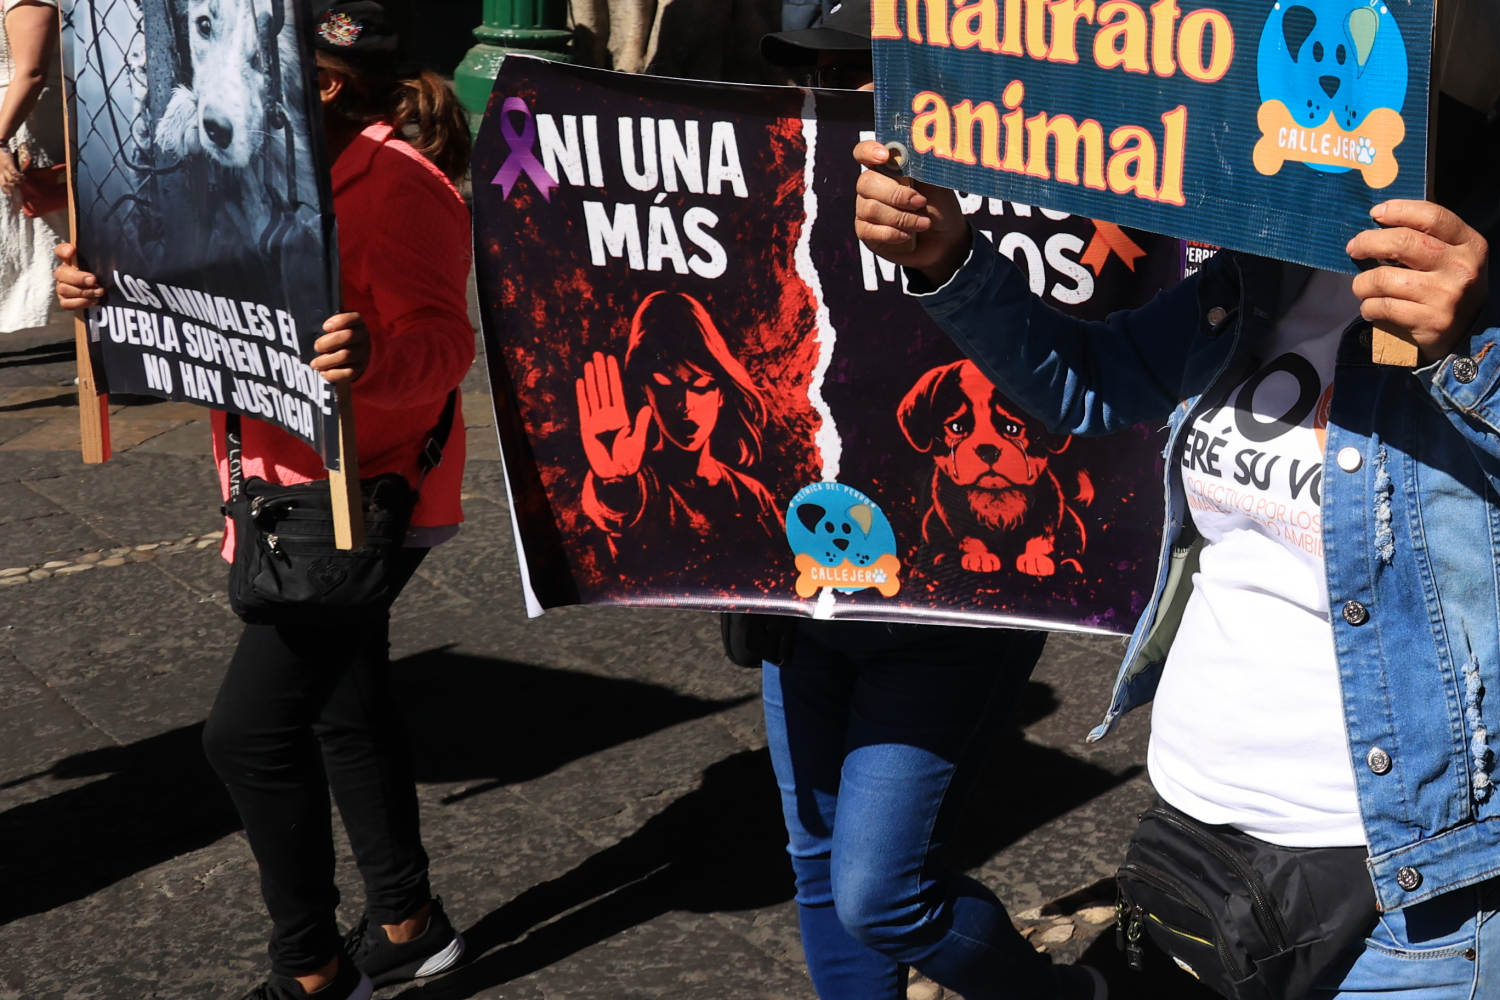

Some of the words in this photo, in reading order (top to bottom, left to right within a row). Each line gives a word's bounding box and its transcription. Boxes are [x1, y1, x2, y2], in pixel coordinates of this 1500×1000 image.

[536, 113, 604, 188] NI
[618, 116, 749, 198] UNA
[911, 79, 1188, 207] animal
[583, 192, 728, 279] MÁS
[90, 305, 181, 353] PUEBLA
[182, 322, 267, 378] SUFREN
[113, 269, 162, 309] LOS
[157, 283, 276, 342] ANIMALES
[142, 353, 173, 394] NO
[179, 360, 225, 405] HAY
[232, 376, 315, 442] JUSTICIA
[1233, 448, 1281, 491] SU
[1255, 498, 1286, 521] POR
[1289, 507, 1321, 534] LOS
